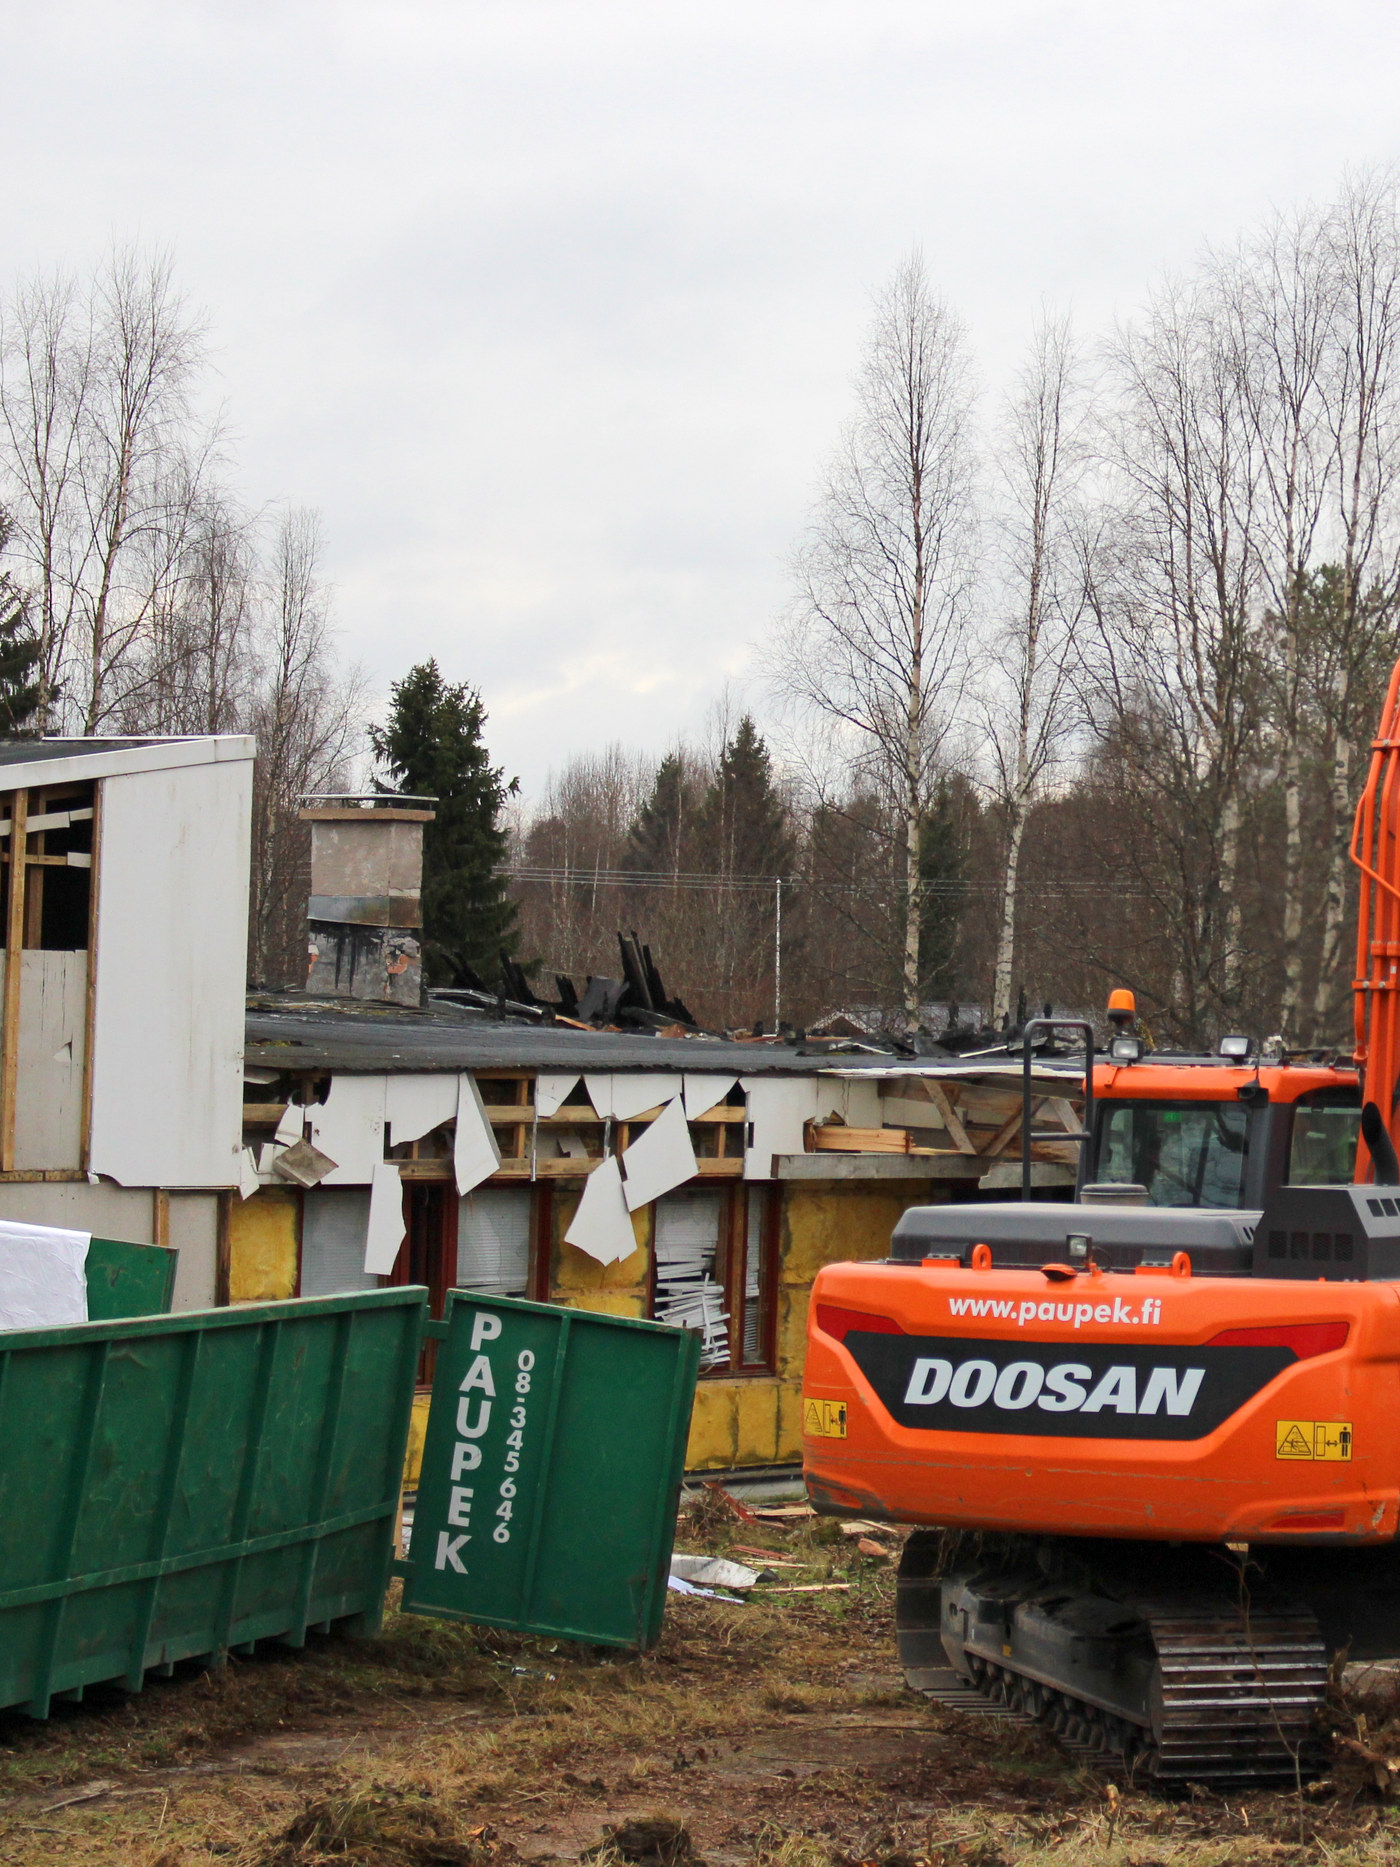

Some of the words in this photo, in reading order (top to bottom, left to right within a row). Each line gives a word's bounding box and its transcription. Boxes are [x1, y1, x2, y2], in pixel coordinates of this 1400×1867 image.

[949, 1297, 1162, 1328] www.paupek.fi
[434, 1311, 502, 1575] PAUPEK
[493, 1350, 535, 1543] 08-345646
[904, 1358, 1206, 1416] DOOSAN
